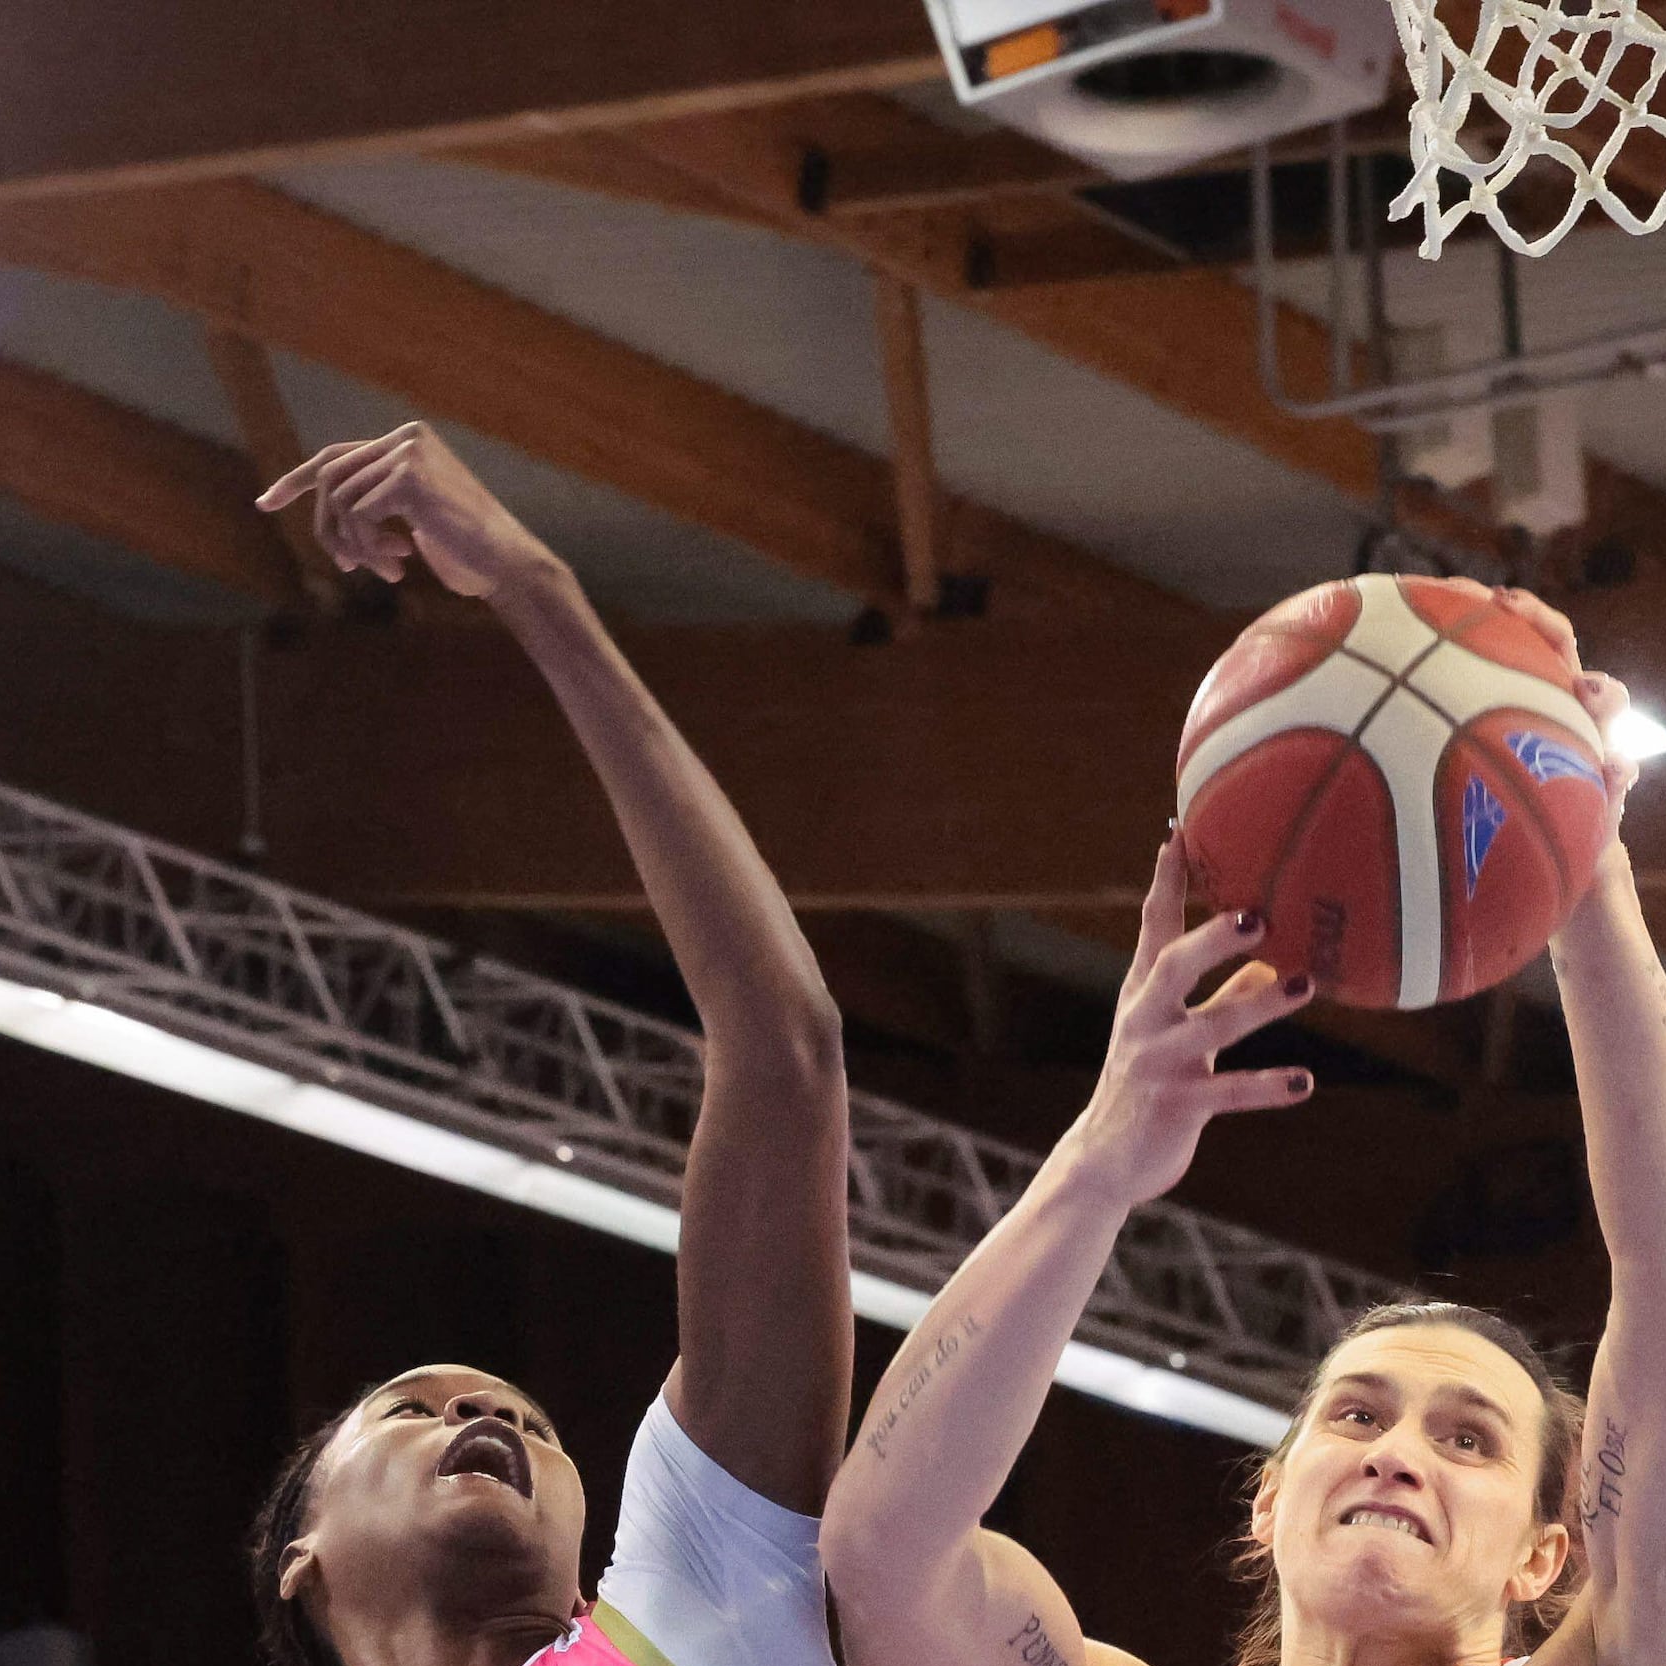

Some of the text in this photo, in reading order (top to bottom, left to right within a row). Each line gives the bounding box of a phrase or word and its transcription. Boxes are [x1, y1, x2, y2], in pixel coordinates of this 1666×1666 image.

[867, 1409, 898, 1460] you
[899, 1366, 931, 1410] can
[935, 1335, 959, 1366] do
